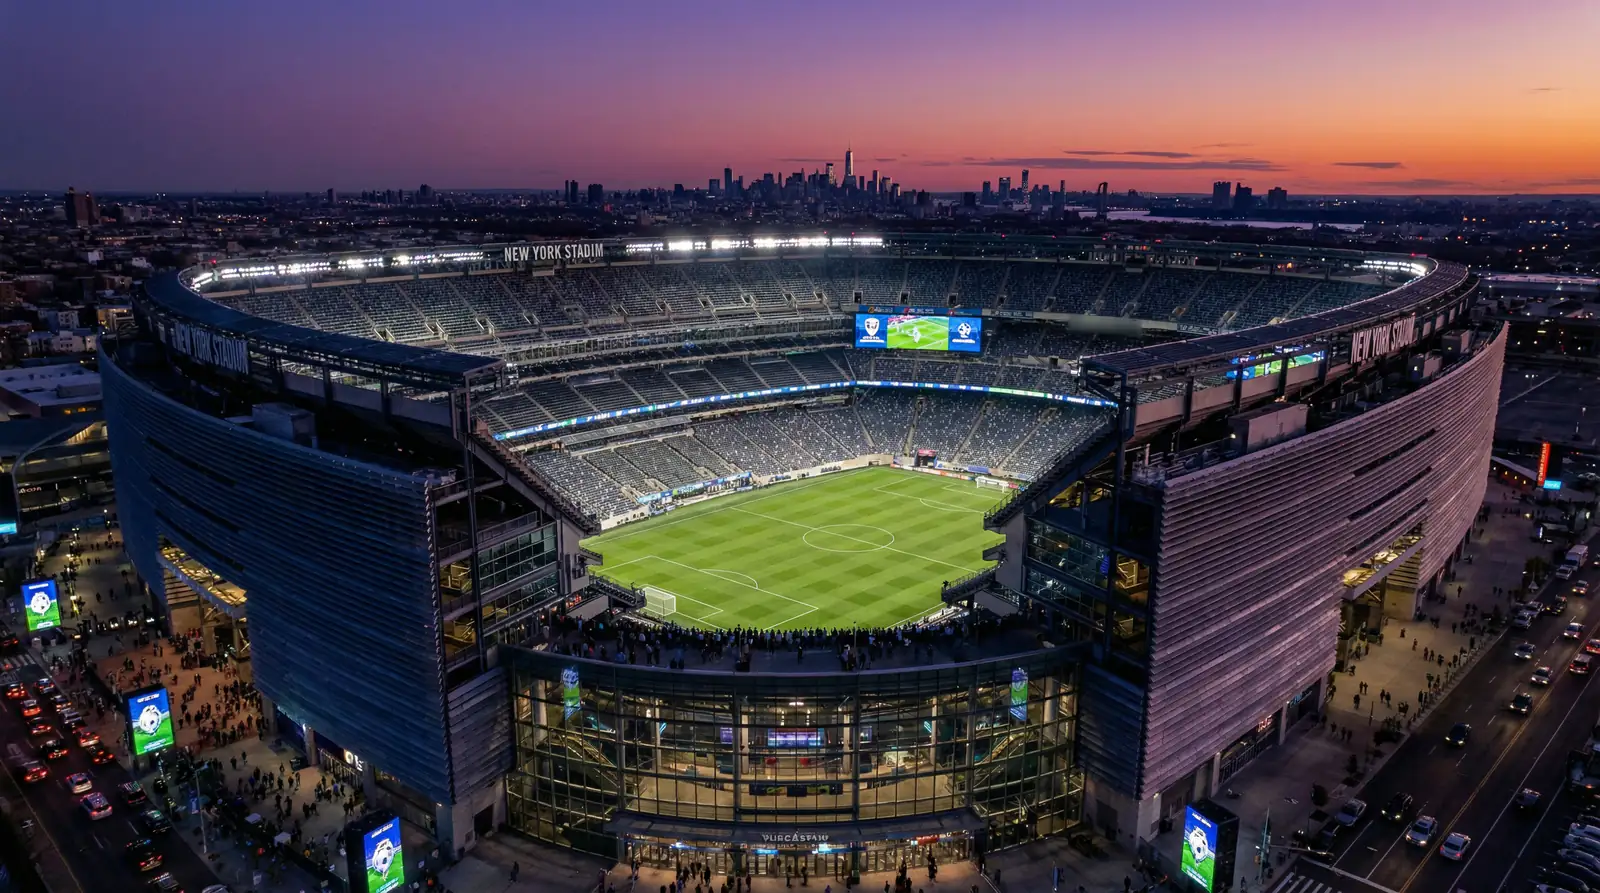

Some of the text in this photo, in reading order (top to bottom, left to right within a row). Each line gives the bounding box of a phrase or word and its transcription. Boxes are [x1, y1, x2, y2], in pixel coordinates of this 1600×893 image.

[504, 243, 604, 262] NEW YORK STADIM
[1350, 329, 1372, 364] NEW
[1372, 323, 1392, 358] YORK
